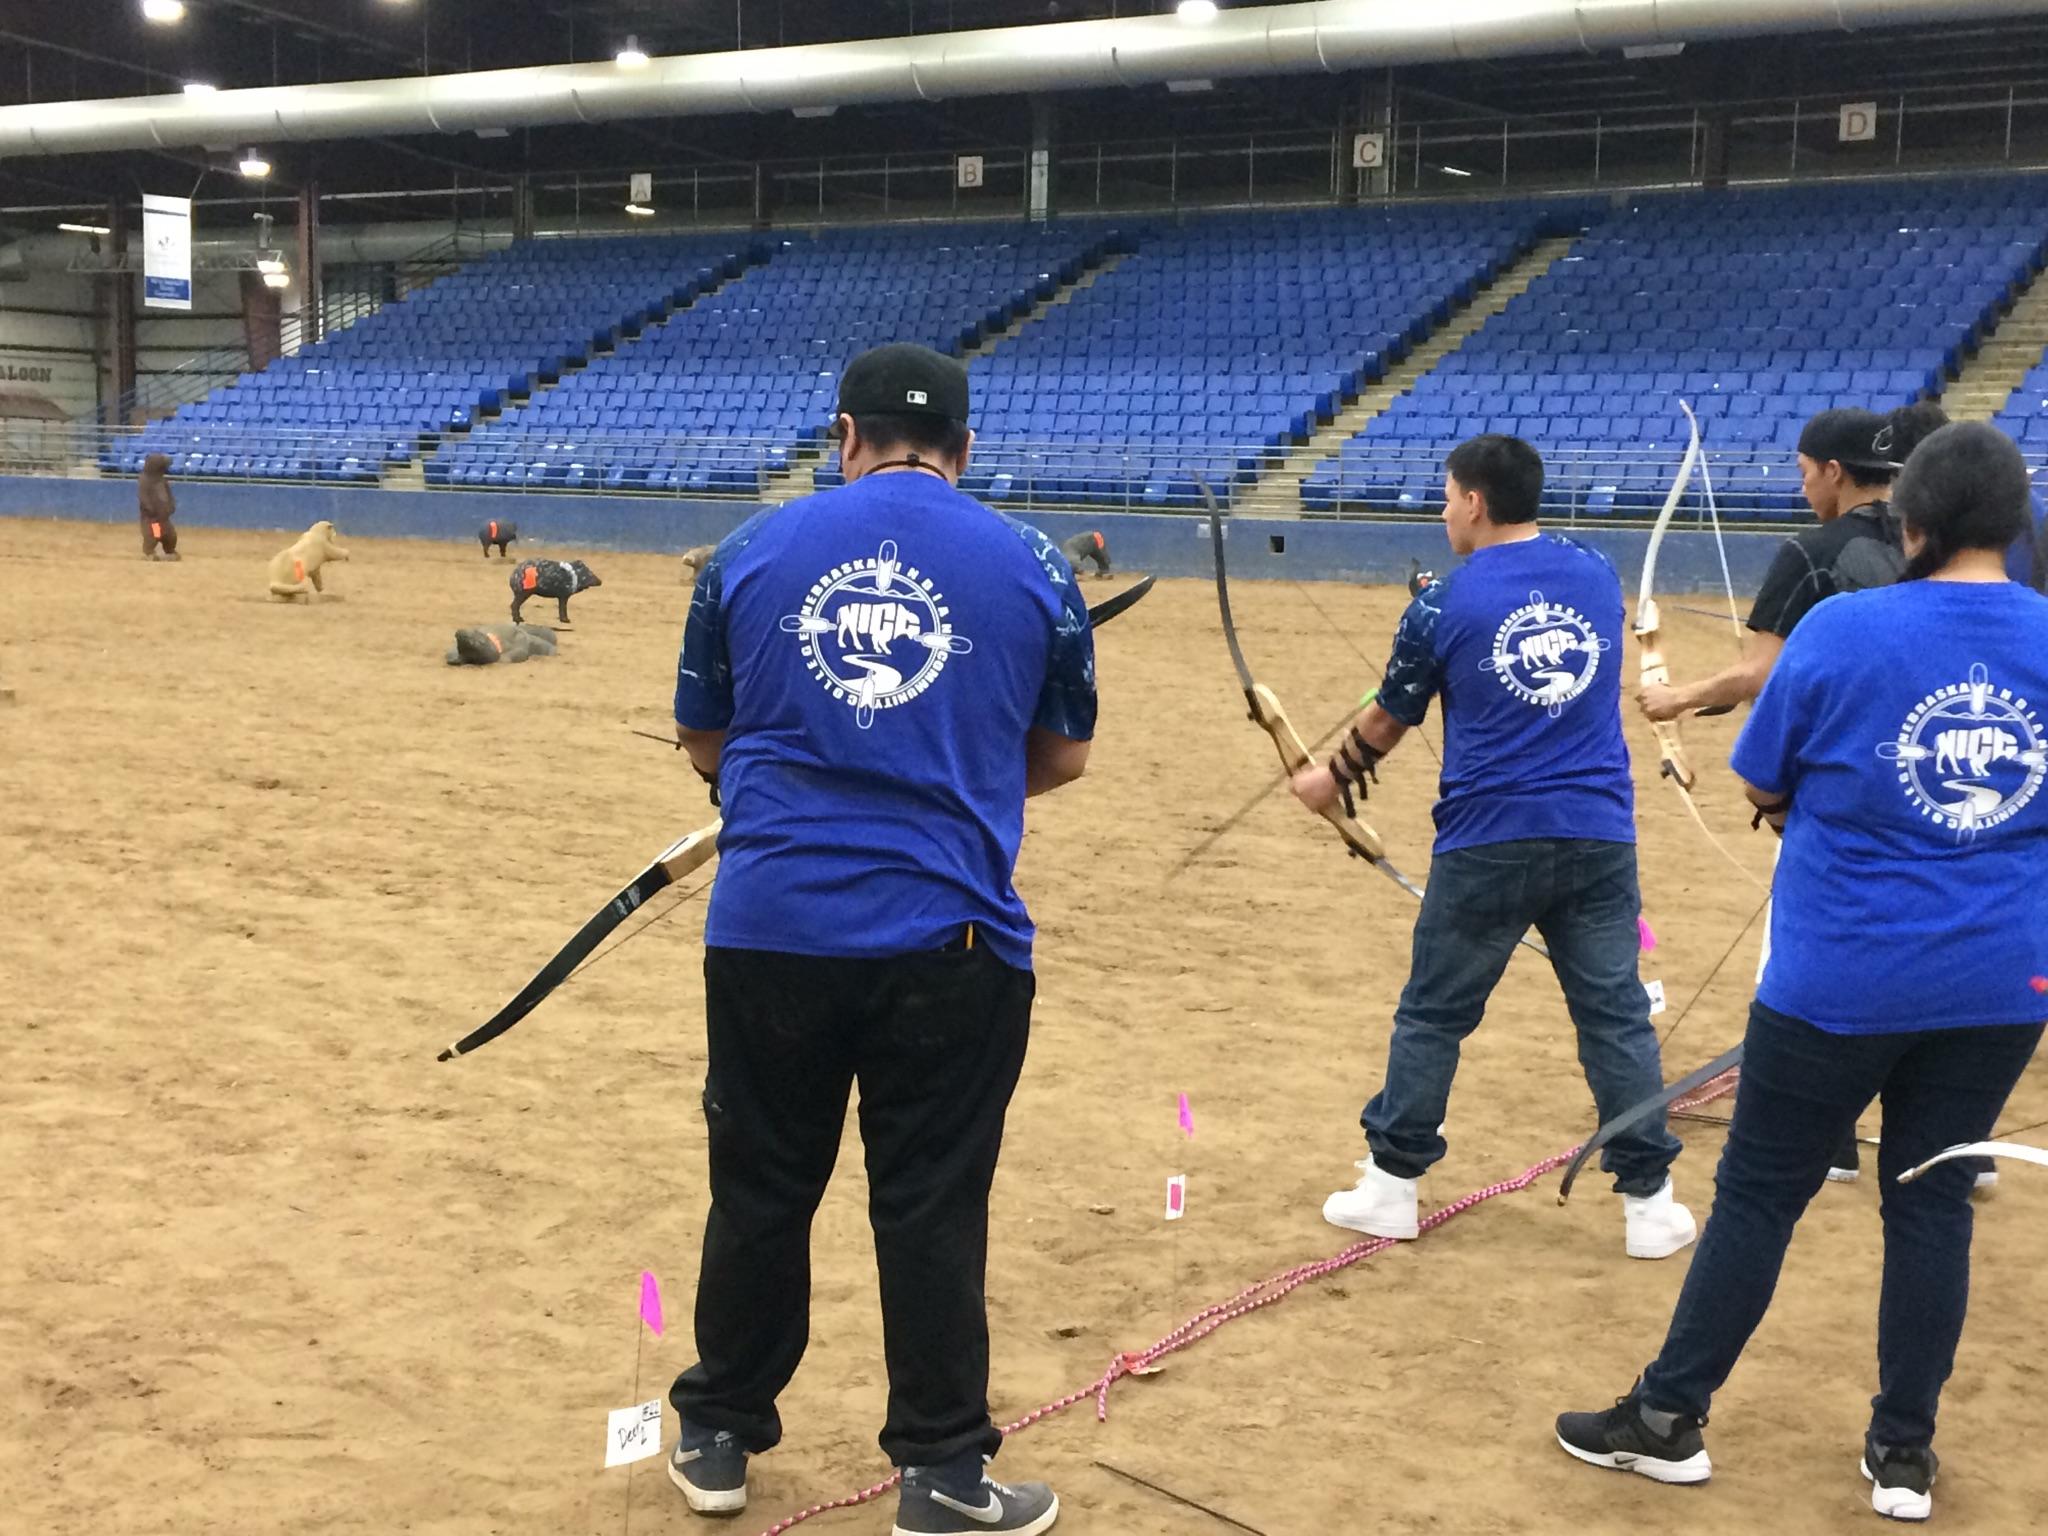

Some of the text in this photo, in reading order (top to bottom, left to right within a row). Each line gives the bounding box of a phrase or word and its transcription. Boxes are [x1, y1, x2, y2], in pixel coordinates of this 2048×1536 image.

[1847, 111, 1868, 136] D
[964, 163, 977, 183] B
[1359, 140, 1377, 164] C
[634, 180, 648, 199] A
[800, 557, 877, 617] NEBRASKA
[895, 561, 953, 635] INDIAN
[837, 602, 920, 654] NICC
[874, 650, 949, 710] COMMUNITY
[1897, 682, 1970, 743] NEBRASKA
[1935, 726, 2019, 776] NICC
[618, 1424, 640, 1450] Deer
